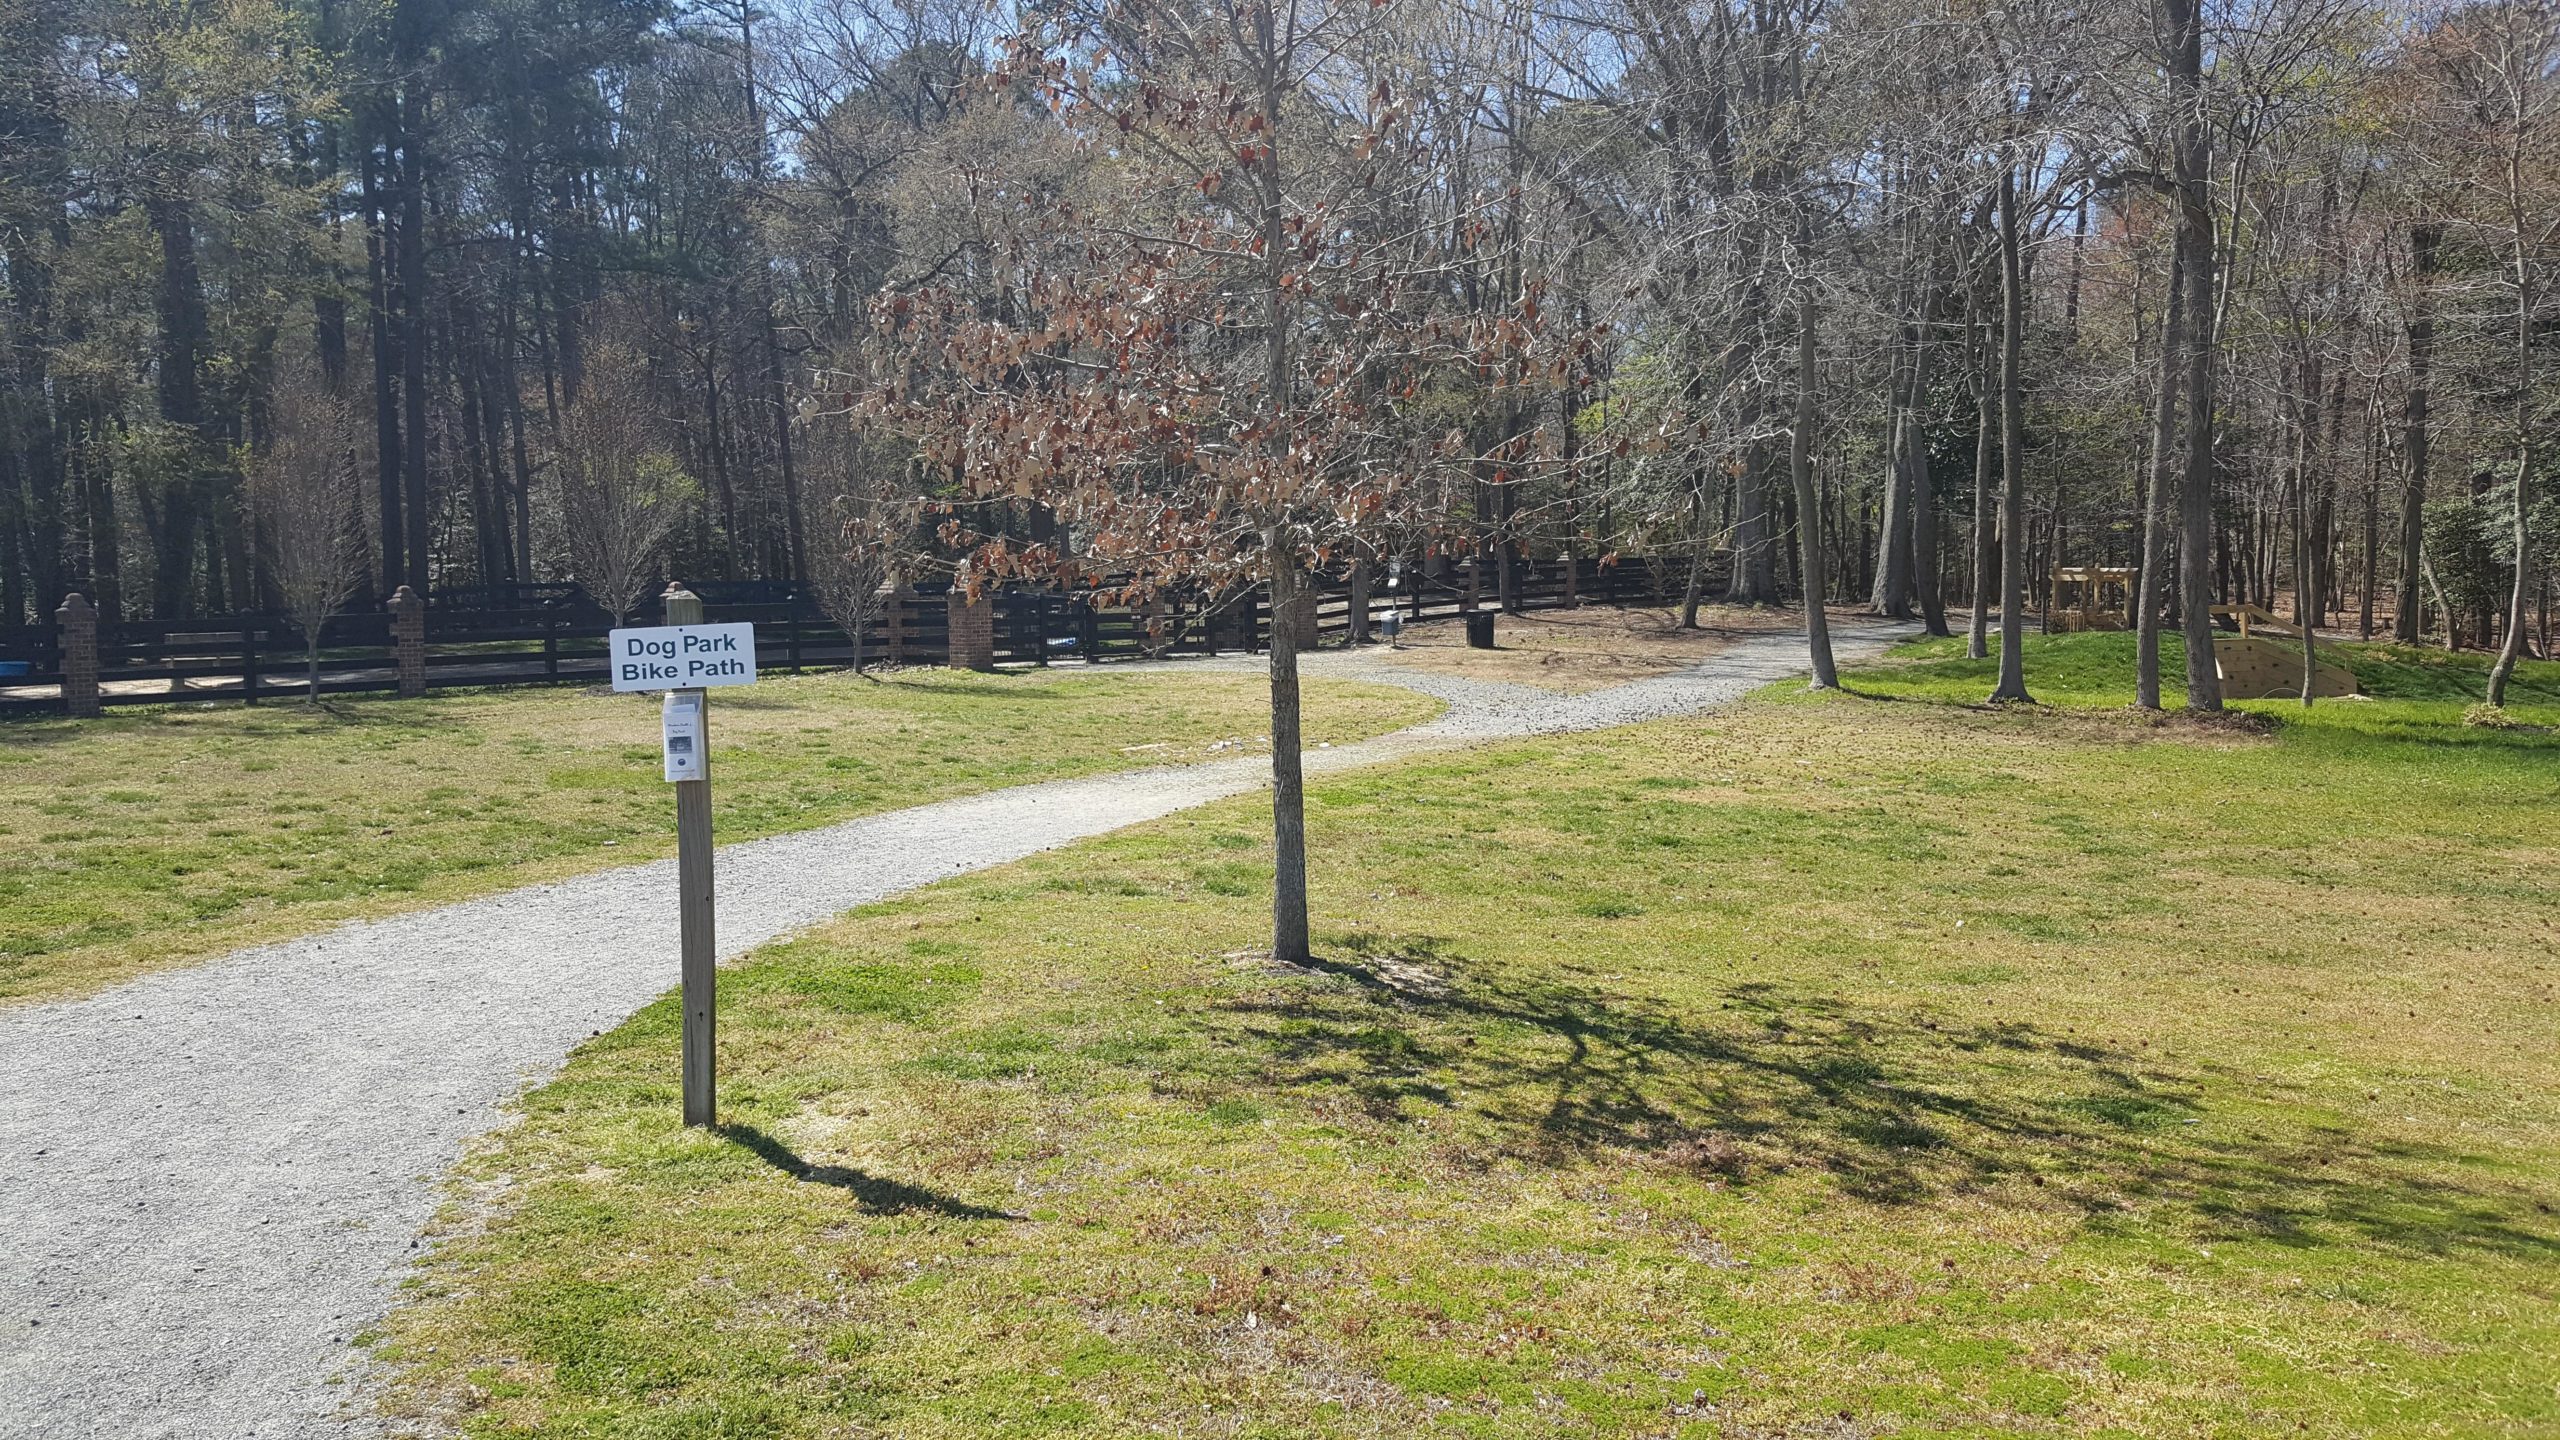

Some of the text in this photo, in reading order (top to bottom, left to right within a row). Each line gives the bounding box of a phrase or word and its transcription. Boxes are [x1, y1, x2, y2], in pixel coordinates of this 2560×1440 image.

[627, 634, 737, 659] Dog Park
[622, 659, 745, 681] Bike Path
